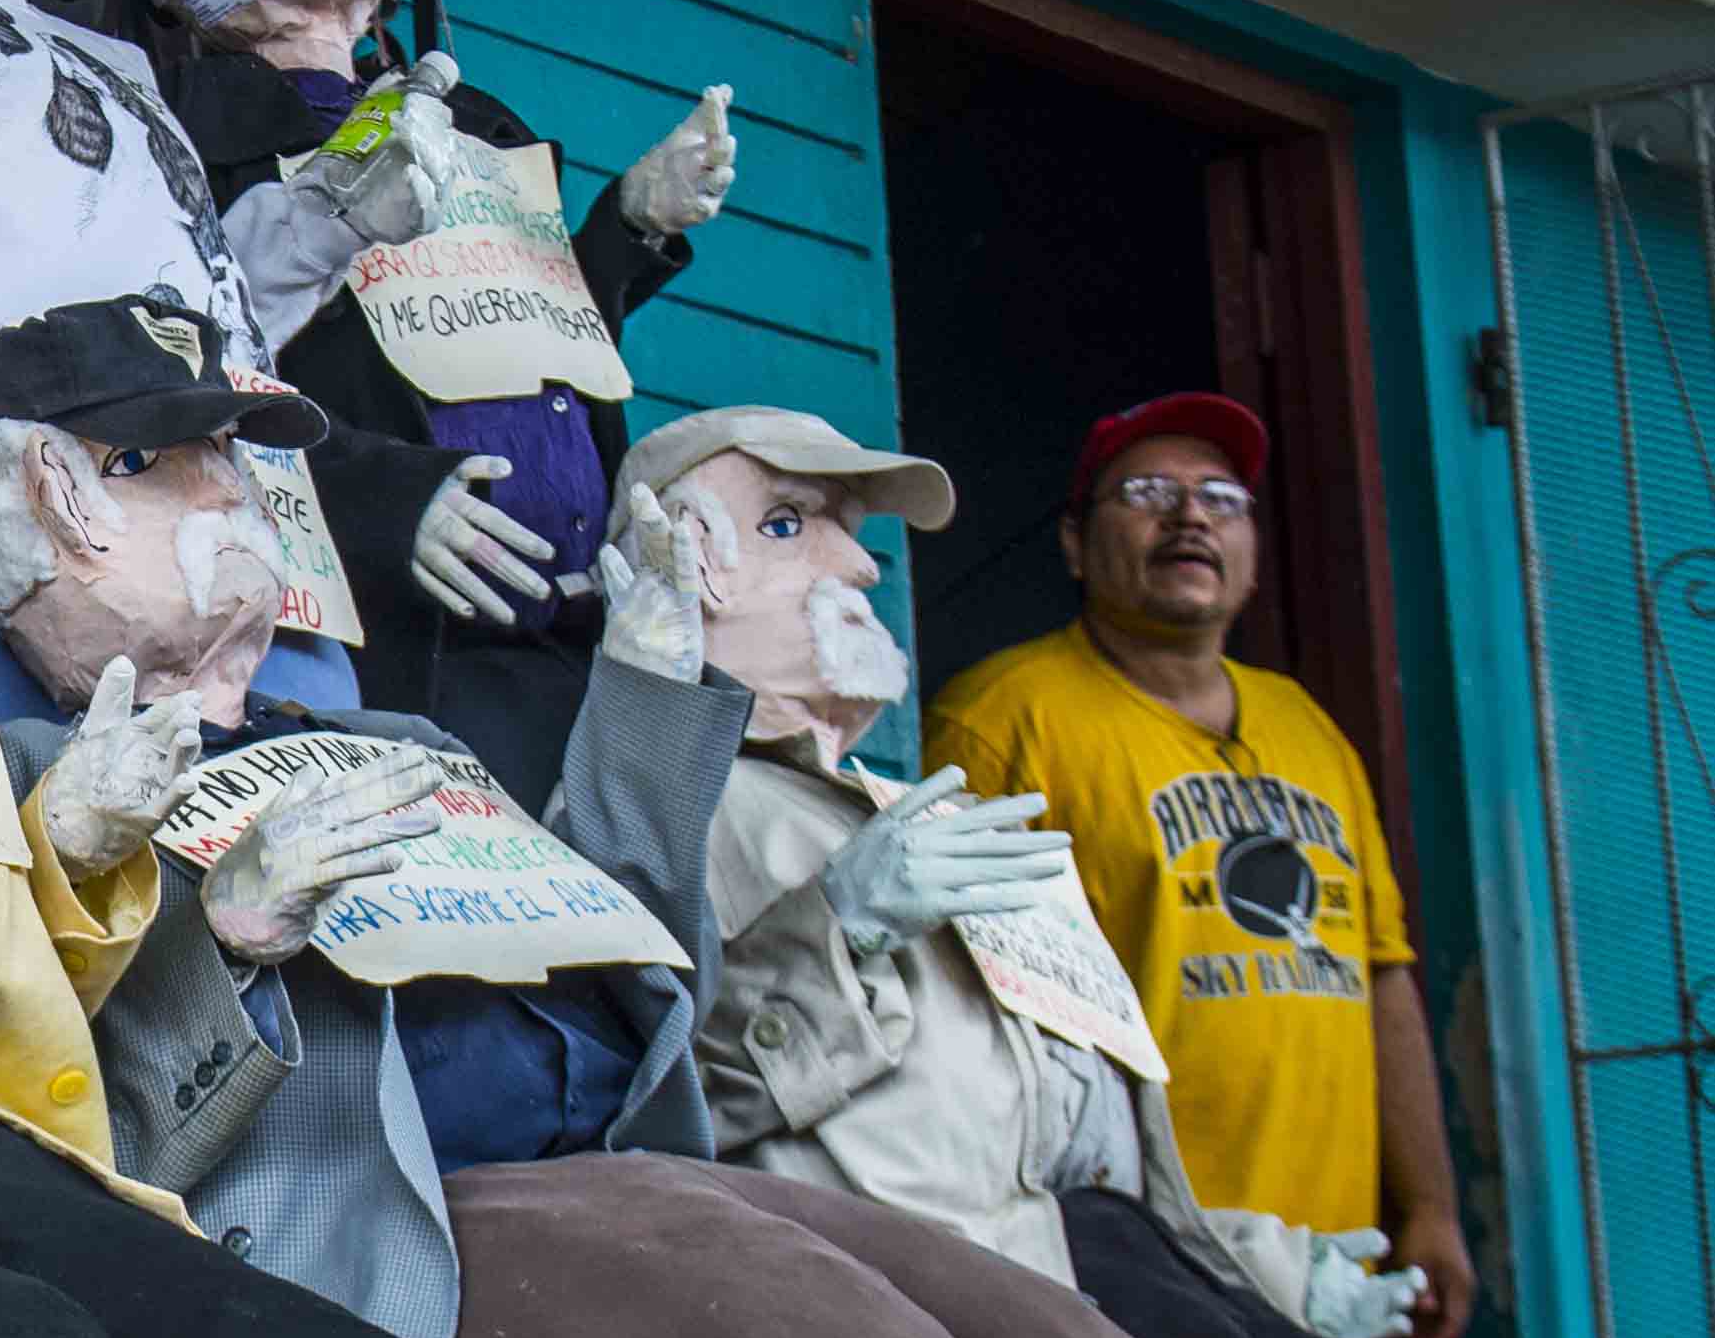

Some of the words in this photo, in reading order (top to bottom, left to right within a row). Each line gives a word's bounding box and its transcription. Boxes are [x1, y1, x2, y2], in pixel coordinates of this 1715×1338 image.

[363, 303, 386, 343] Y
[390, 295, 425, 341] ME
[278, 584, 322, 630] AD
[198, 767, 260, 811] NO
[1149, 773, 1360, 871] AIRBORNE
[1179, 878, 1217, 907] M
[1179, 954, 1249, 1000] SKY
